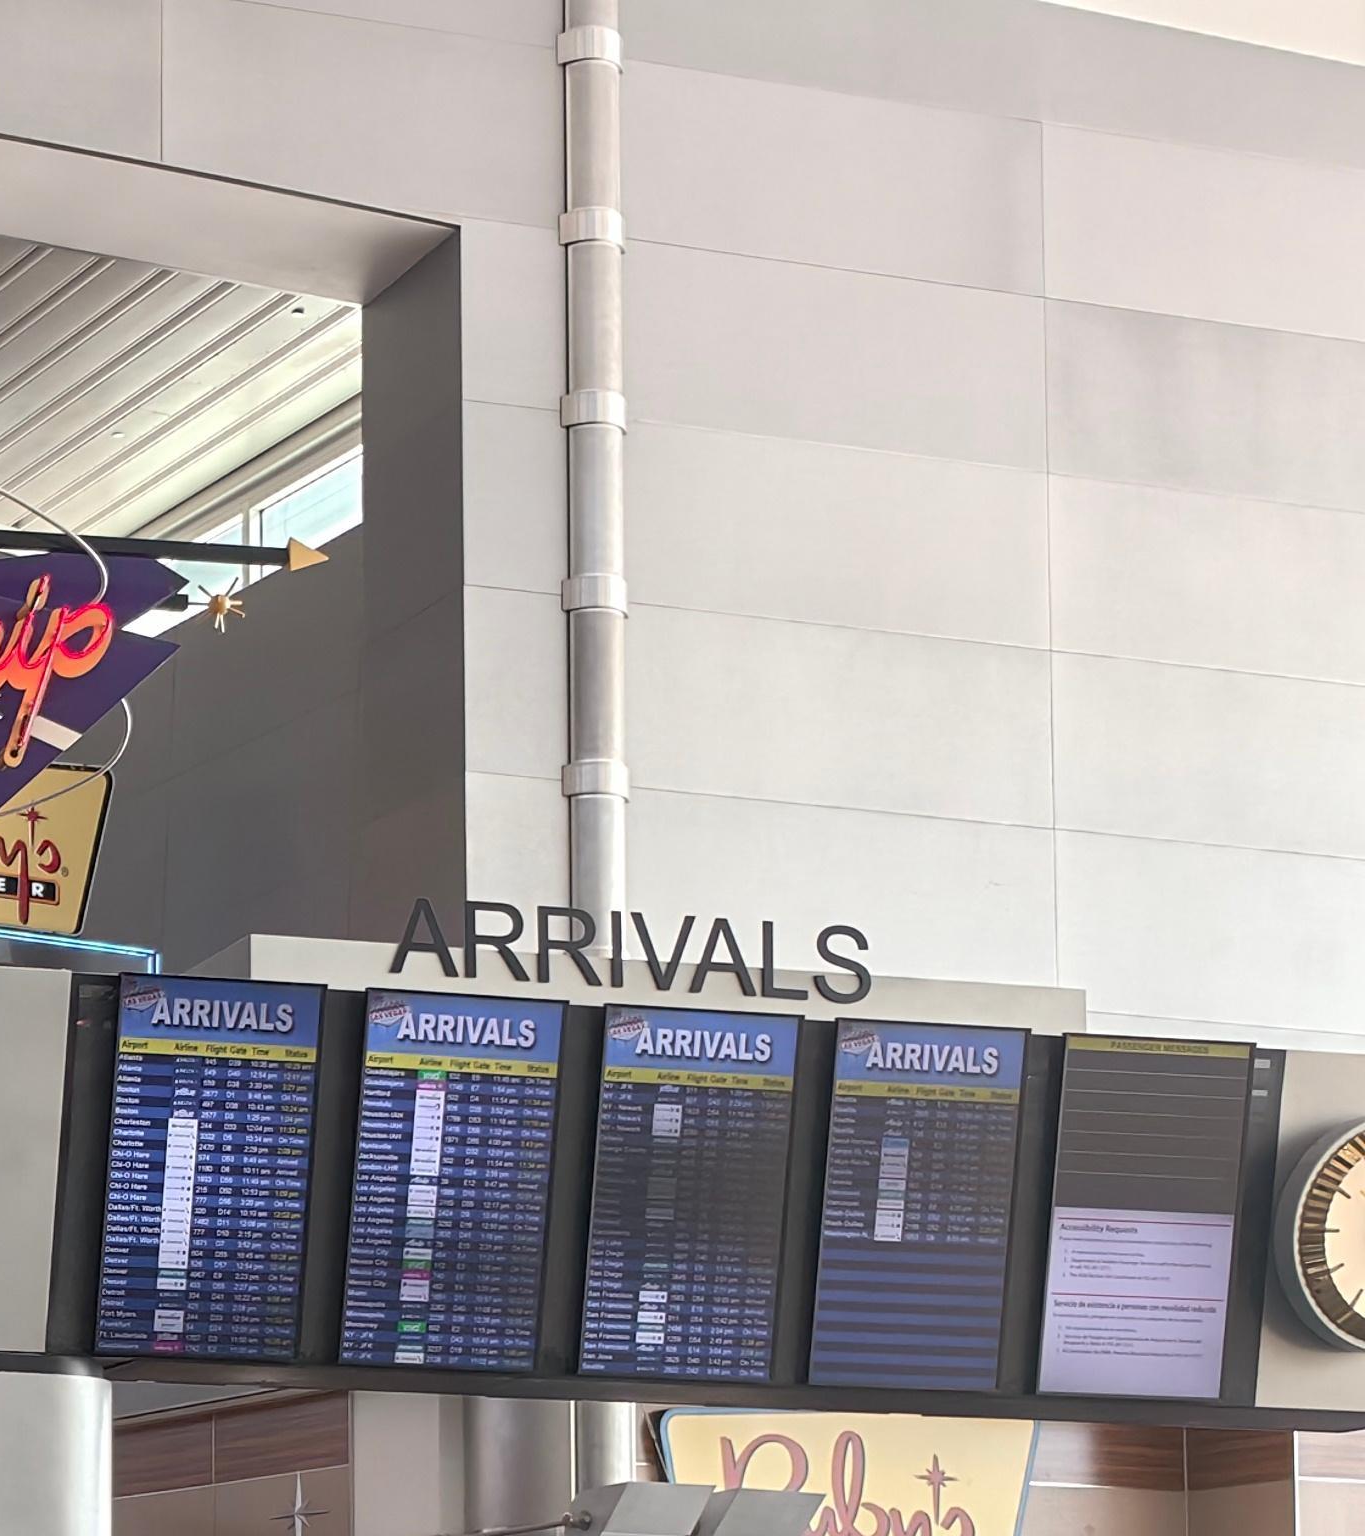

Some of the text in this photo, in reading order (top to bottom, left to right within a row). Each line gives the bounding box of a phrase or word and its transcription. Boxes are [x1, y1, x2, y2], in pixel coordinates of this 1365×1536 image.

[389, 898, 872, 1004] ARRIVALS
[151, 998, 293, 1032] ARRIVALS
[396, 1013, 535, 1047] ARRIVALS
[121, 1040, 308, 1058] Airport Airline Flight Gate Time Status
[635, 1028, 772, 1062] ARRIVALS
[866, 1042, 999, 1074] ARRIVALS
